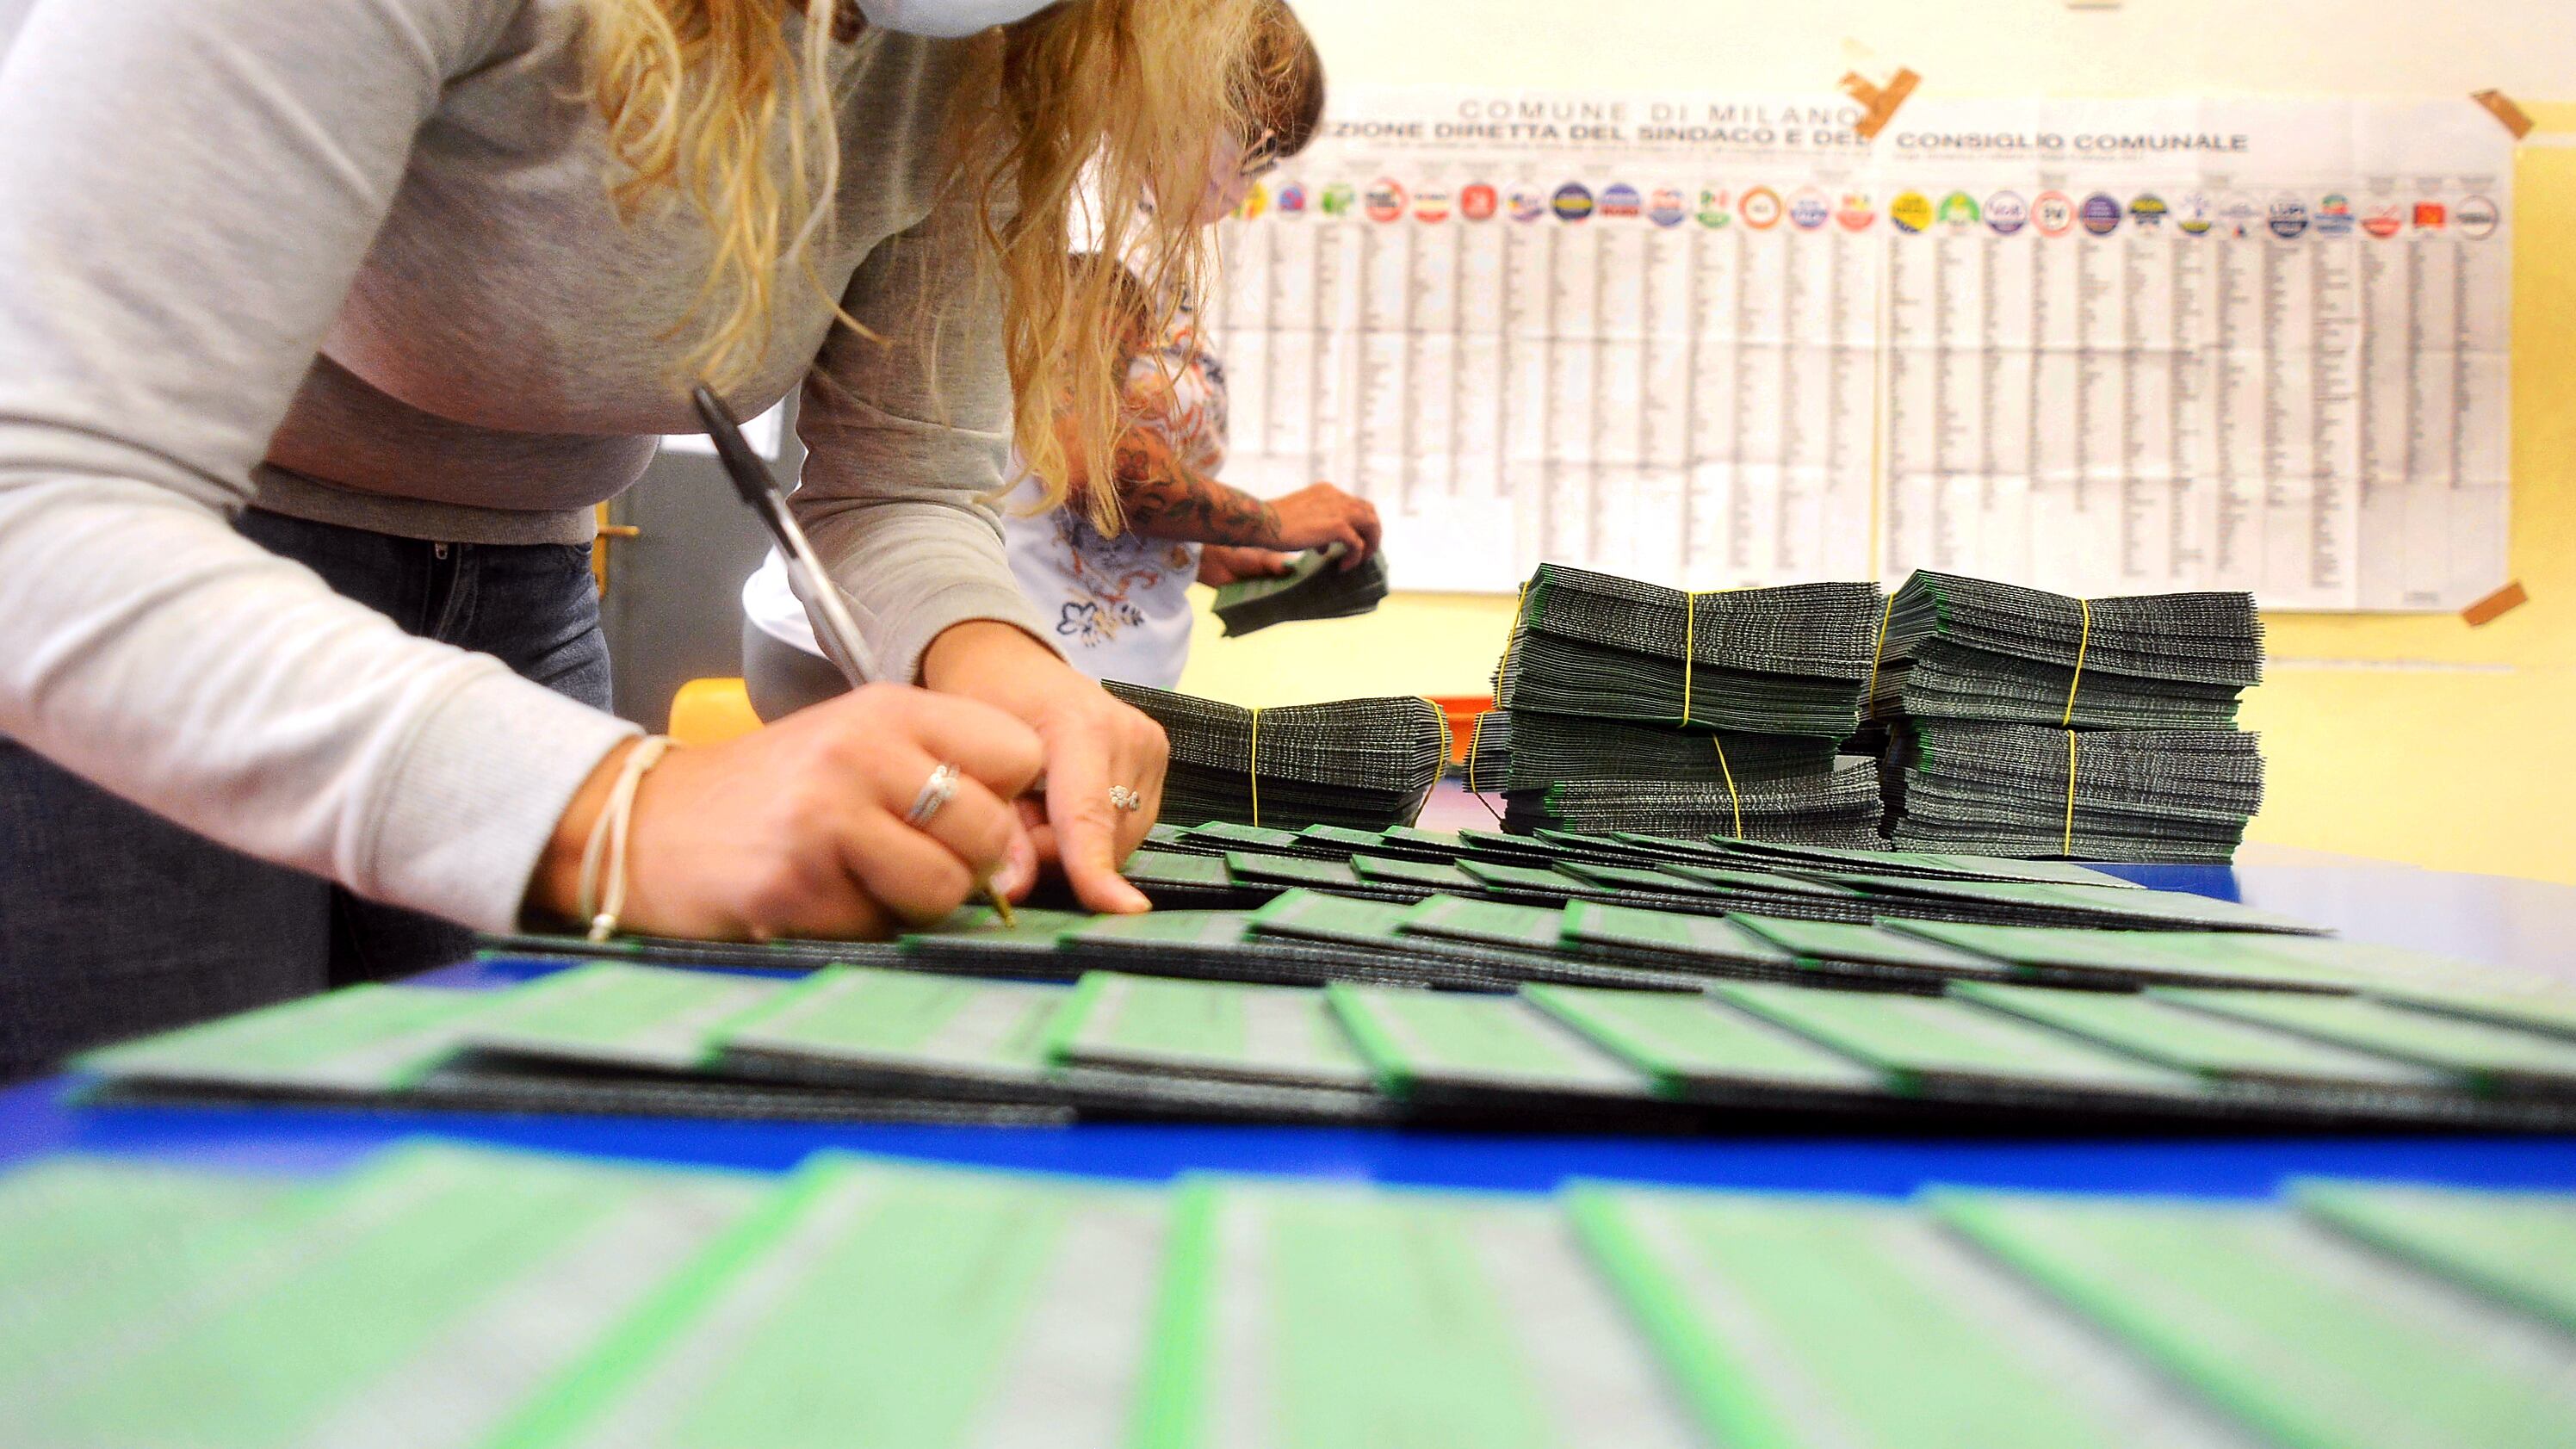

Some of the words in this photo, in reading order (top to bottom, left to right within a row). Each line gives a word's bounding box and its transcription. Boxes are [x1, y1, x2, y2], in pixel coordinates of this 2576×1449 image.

[1458, 99, 1627, 121] COMUNE
[1651, 102, 1687, 122] DI
[1709, 104, 1861, 127] MILANO
[1434, 123, 1560, 139] DIRETTA
[1570, 124, 1625, 140] DEL
[1638, 127, 1775, 144] SINDACO
[1786, 129, 1802, 146] E
[1897, 132, 2065, 151] CONSIGLIO
[2073, 134, 2248, 152] COMUNALE
